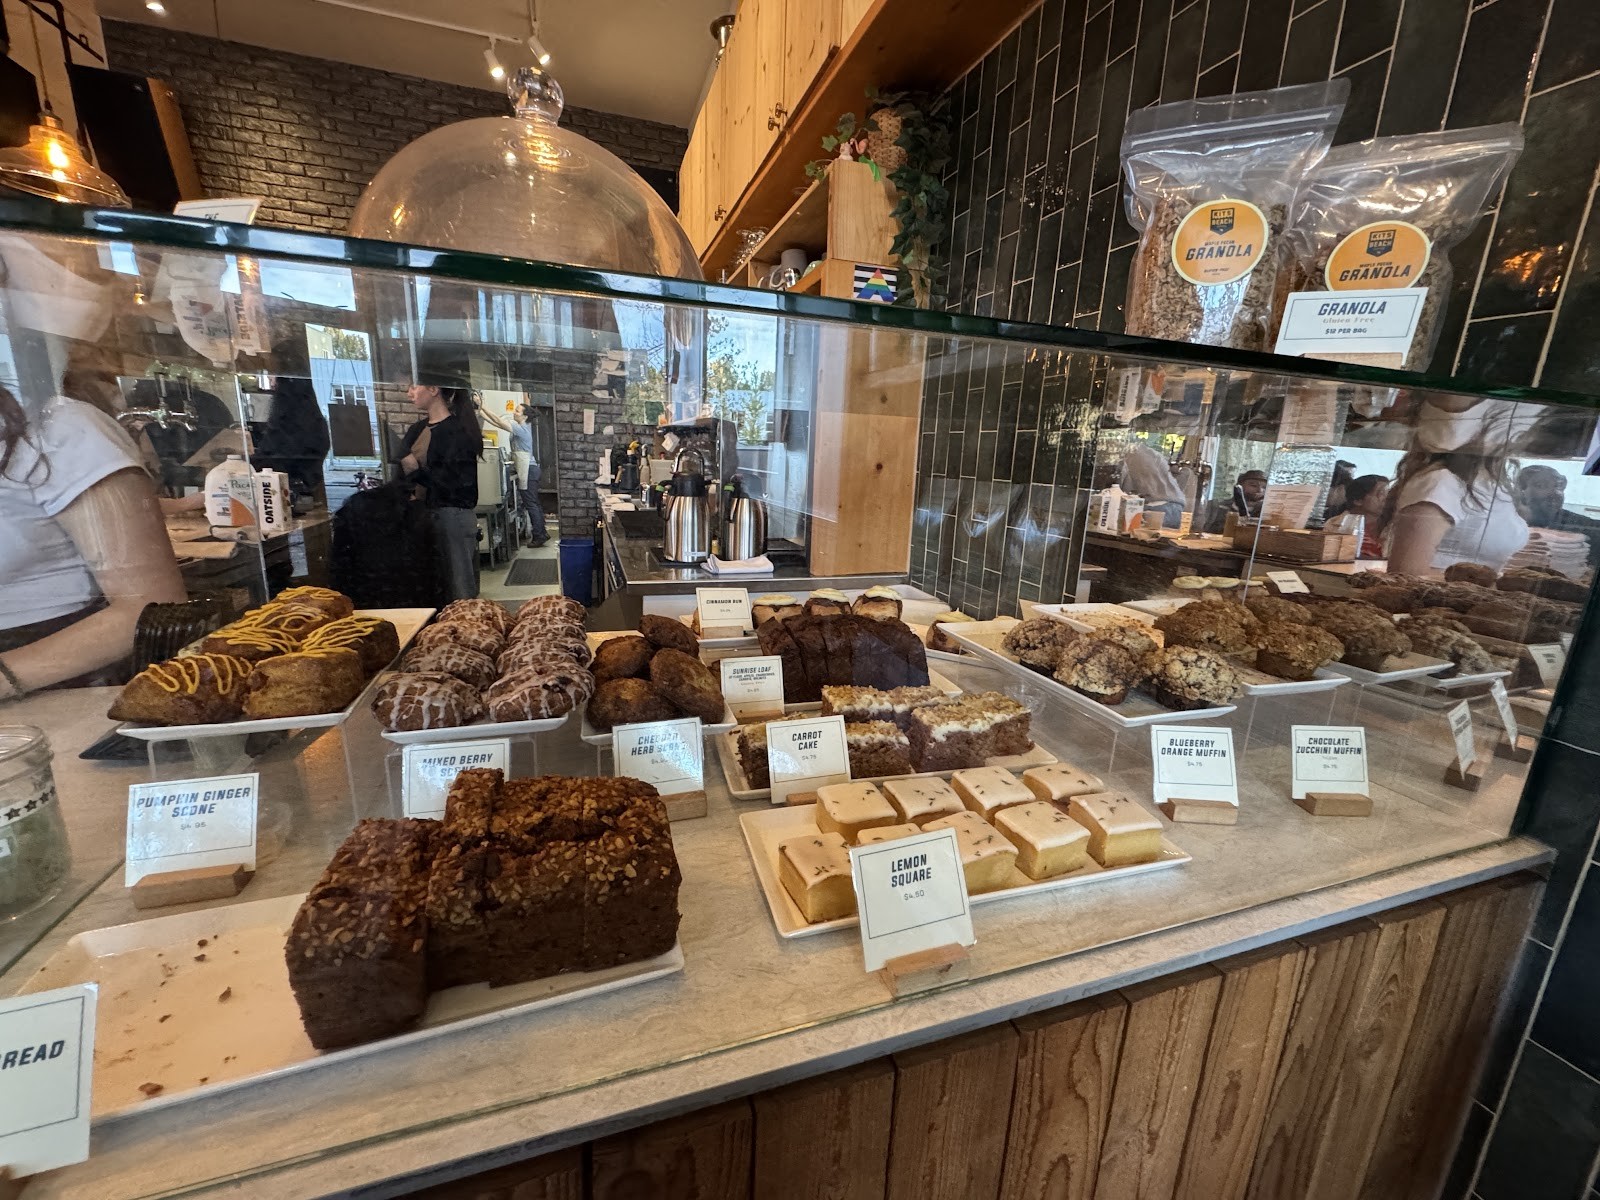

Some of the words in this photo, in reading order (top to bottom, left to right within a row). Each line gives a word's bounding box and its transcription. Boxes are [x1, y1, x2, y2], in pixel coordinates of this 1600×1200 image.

[1186, 244, 1252, 261] GRANOLA
[1339, 265, 1411, 281] GRANOLA
[1318, 301, 1387, 316] GRANOLA
[262, 481, 274, 524] OATSIDE
[792, 731, 822, 742] CARROT
[1169, 738, 1215, 748] BLUEBERRY
[1308, 737, 1350, 746] CHOCOLATE
[631, 745, 655, 756] HERB
[798, 741, 818, 751] CAKE
[1161, 747, 1194, 756] ORANGE
[1196, 748, 1226, 757] MUFFIN
[1296, 746, 1331, 754] ZUCCHINI
[1334, 747, 1362, 755] MUFFIN
[422, 756, 456, 768] MIXED
[459, 753, 493, 765] BERRY
[137, 792, 199, 808] PUMPKIN
[203, 787, 250, 802] GINGER
[172, 803, 216, 817] SCONE
[892, 854, 926, 872] LEMON
[892, 868, 931, 887] SQUARE
[904, 889, 925, 901] $4.50
[0, 1040, 65, 1070] READ
